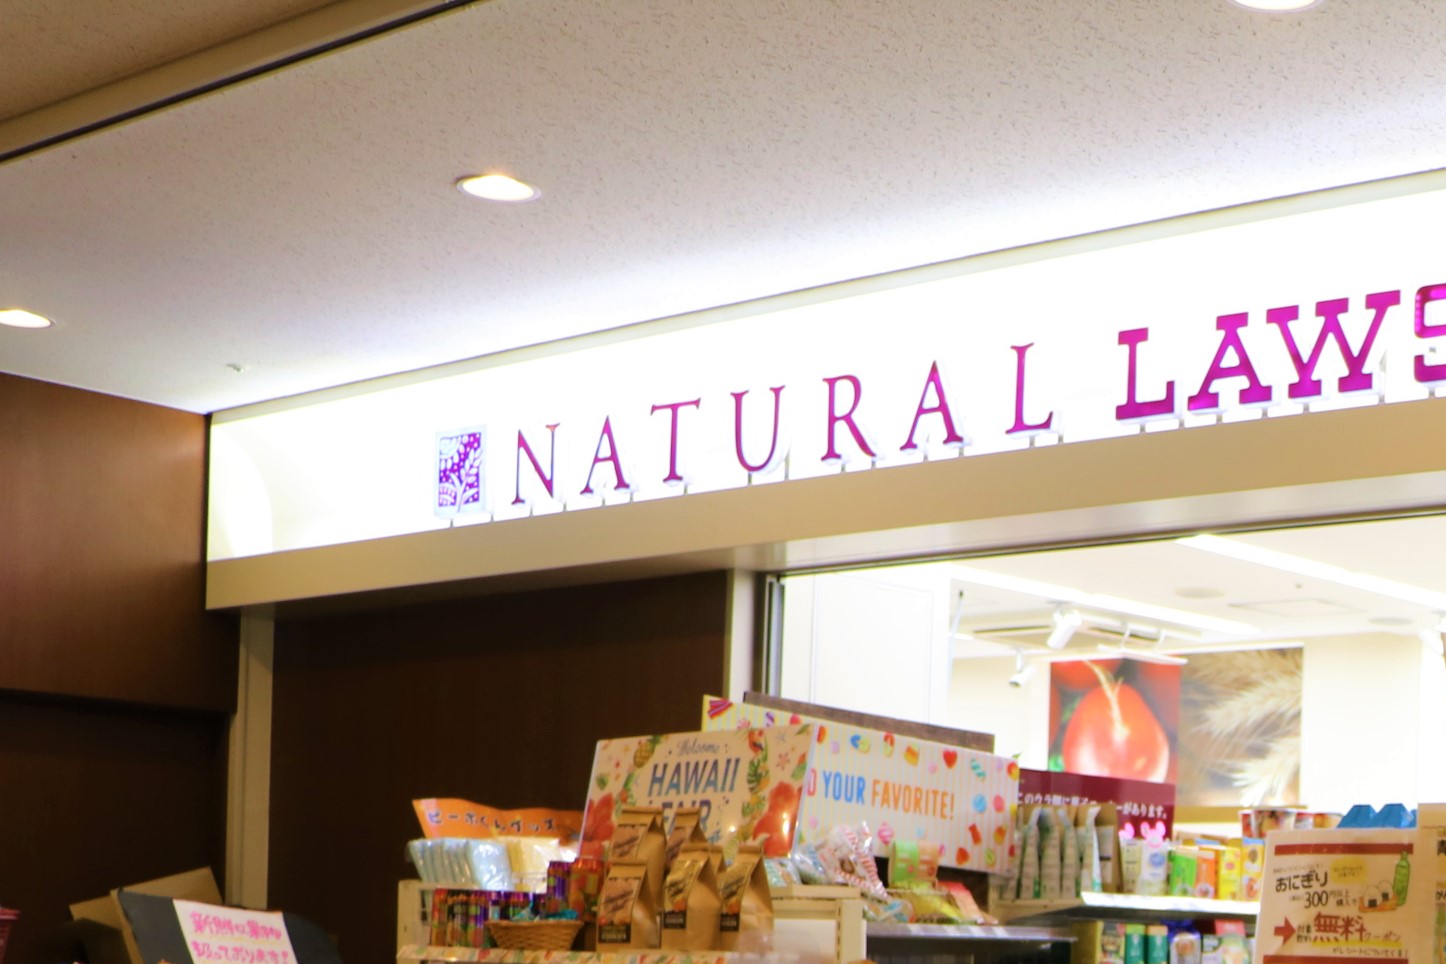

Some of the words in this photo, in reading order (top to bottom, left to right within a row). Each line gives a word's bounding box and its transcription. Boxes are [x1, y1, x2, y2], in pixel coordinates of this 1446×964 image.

[511, 343, 1053, 505] NATURAL
[647, 757, 741, 797] HAWAII
[823, 770, 866, 805] YOUR
[871, 779, 956, 821] FAVORITE!
[1275, 868, 1328, 892] おにぎり
[1304, 890, 1329, 909] 300
